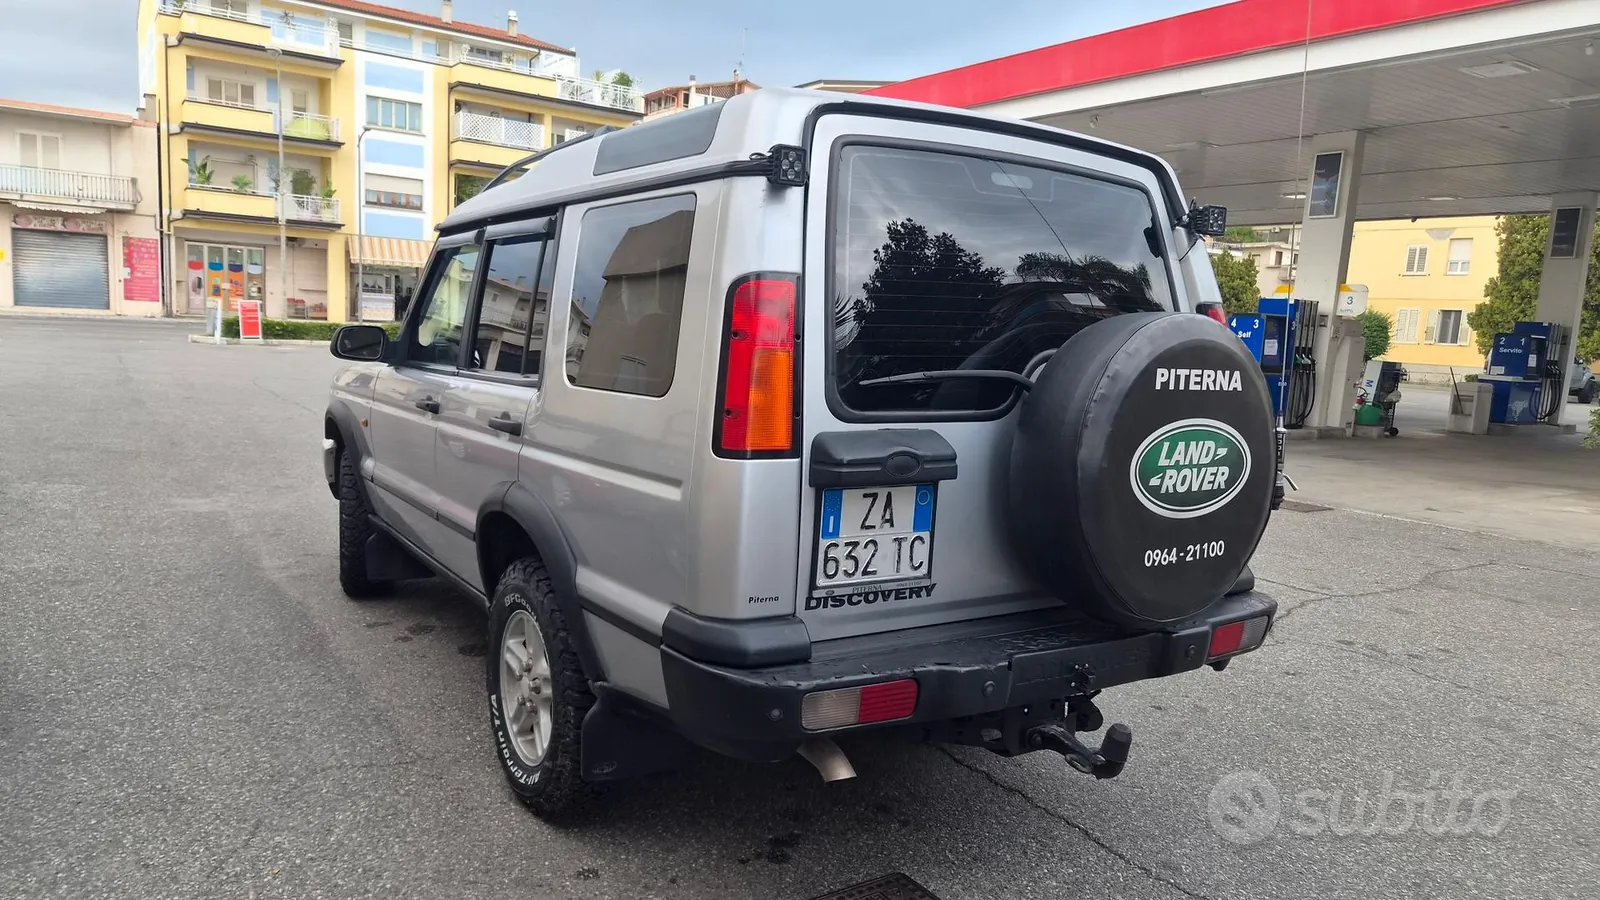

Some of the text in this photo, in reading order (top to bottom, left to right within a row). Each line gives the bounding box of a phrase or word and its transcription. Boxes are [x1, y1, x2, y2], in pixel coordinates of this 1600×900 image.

[1346, 296, 1354, 305] 3
[1231, 318, 1237, 328] 4
[1253, 319, 1259, 329] 3
[1500, 337, 1506, 345] 2
[1155, 368, 1242, 392] PITERNA
[1158, 440, 1216, 467] LAND
[1160, 466, 1230, 494] ROVER
[860, 491, 895, 530] ZA
[823, 535, 926, 579] 632 TC
[804, 583, 937, 611] DISCOVERY
[852, 584, 883, 594] PITERNA
[748, 596, 779, 604] Piterna
